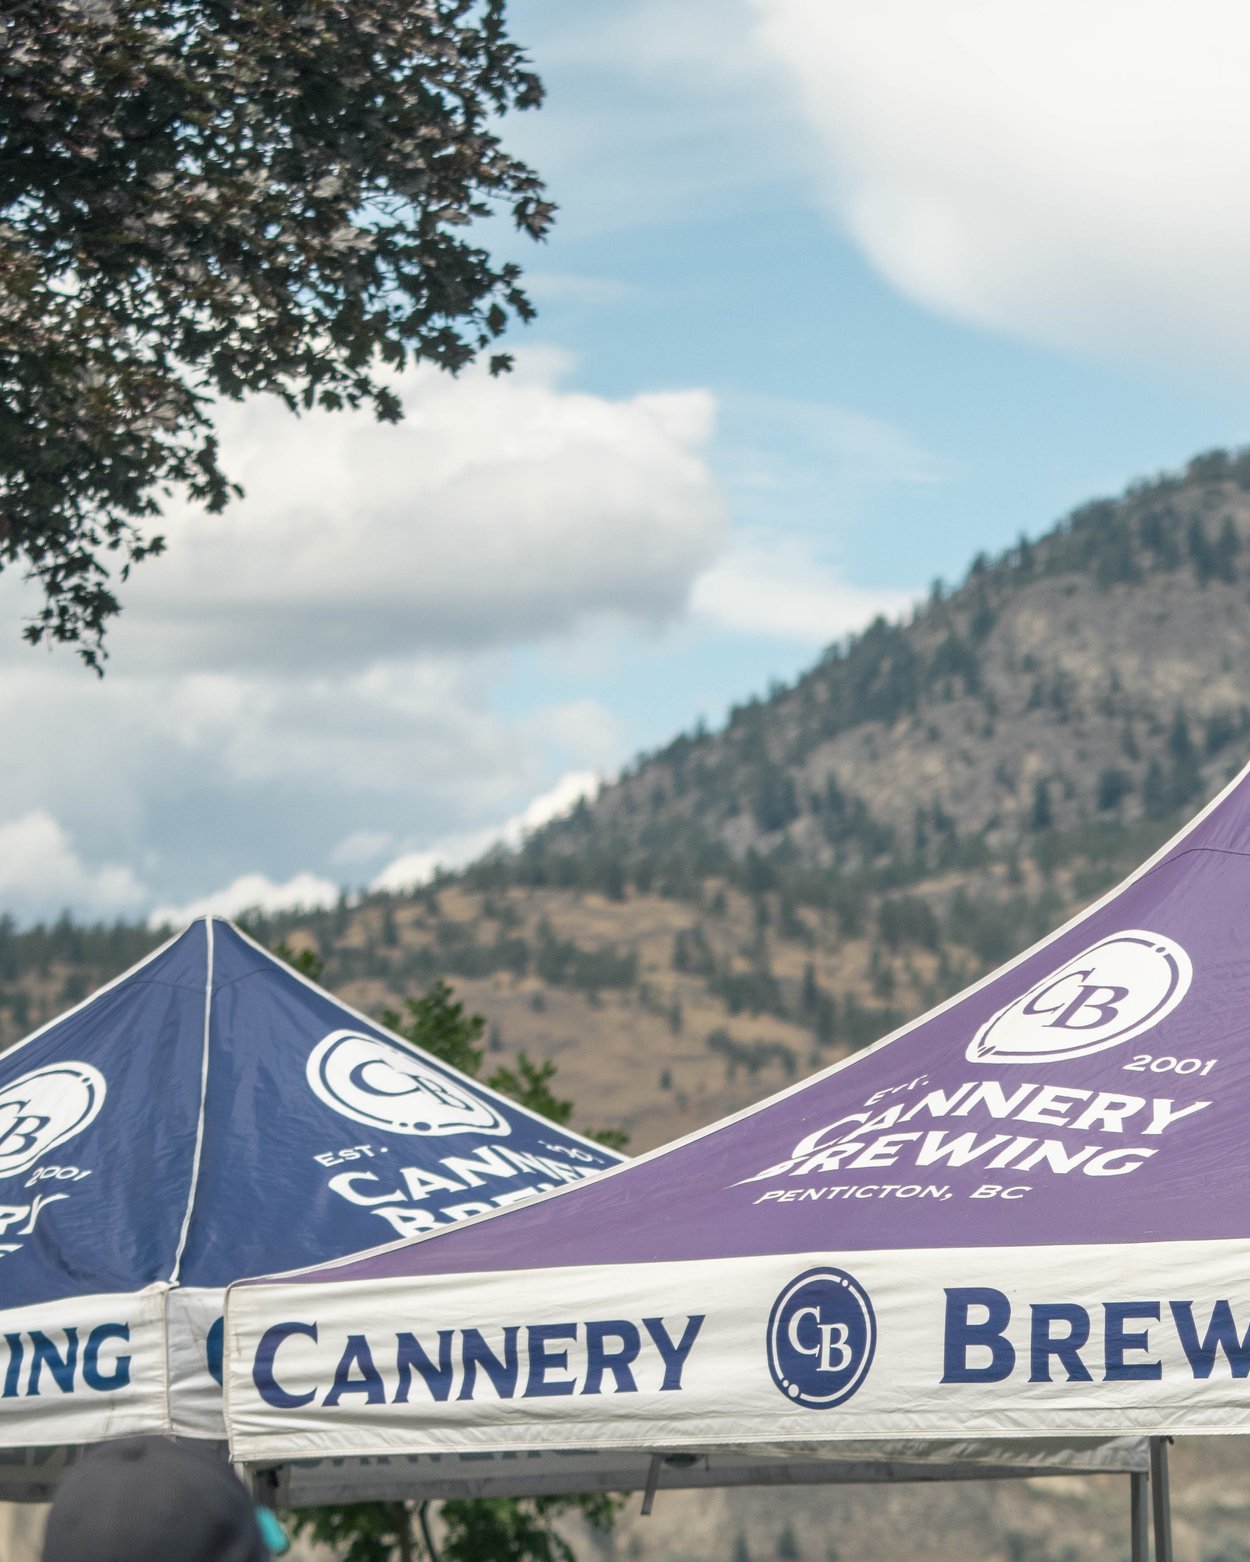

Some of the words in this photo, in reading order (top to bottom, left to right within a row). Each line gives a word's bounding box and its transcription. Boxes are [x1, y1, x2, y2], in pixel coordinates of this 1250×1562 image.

[1123, 1055, 1218, 1077] 2001
[792, 1081, 1213, 1160] CANNERY
[751, 1184, 953, 1205] PENTICTON,
[969, 1185, 1033, 1200] BC
[252, 1314, 707, 1410] CANNERY
[788, 1307, 853, 1373] CB
